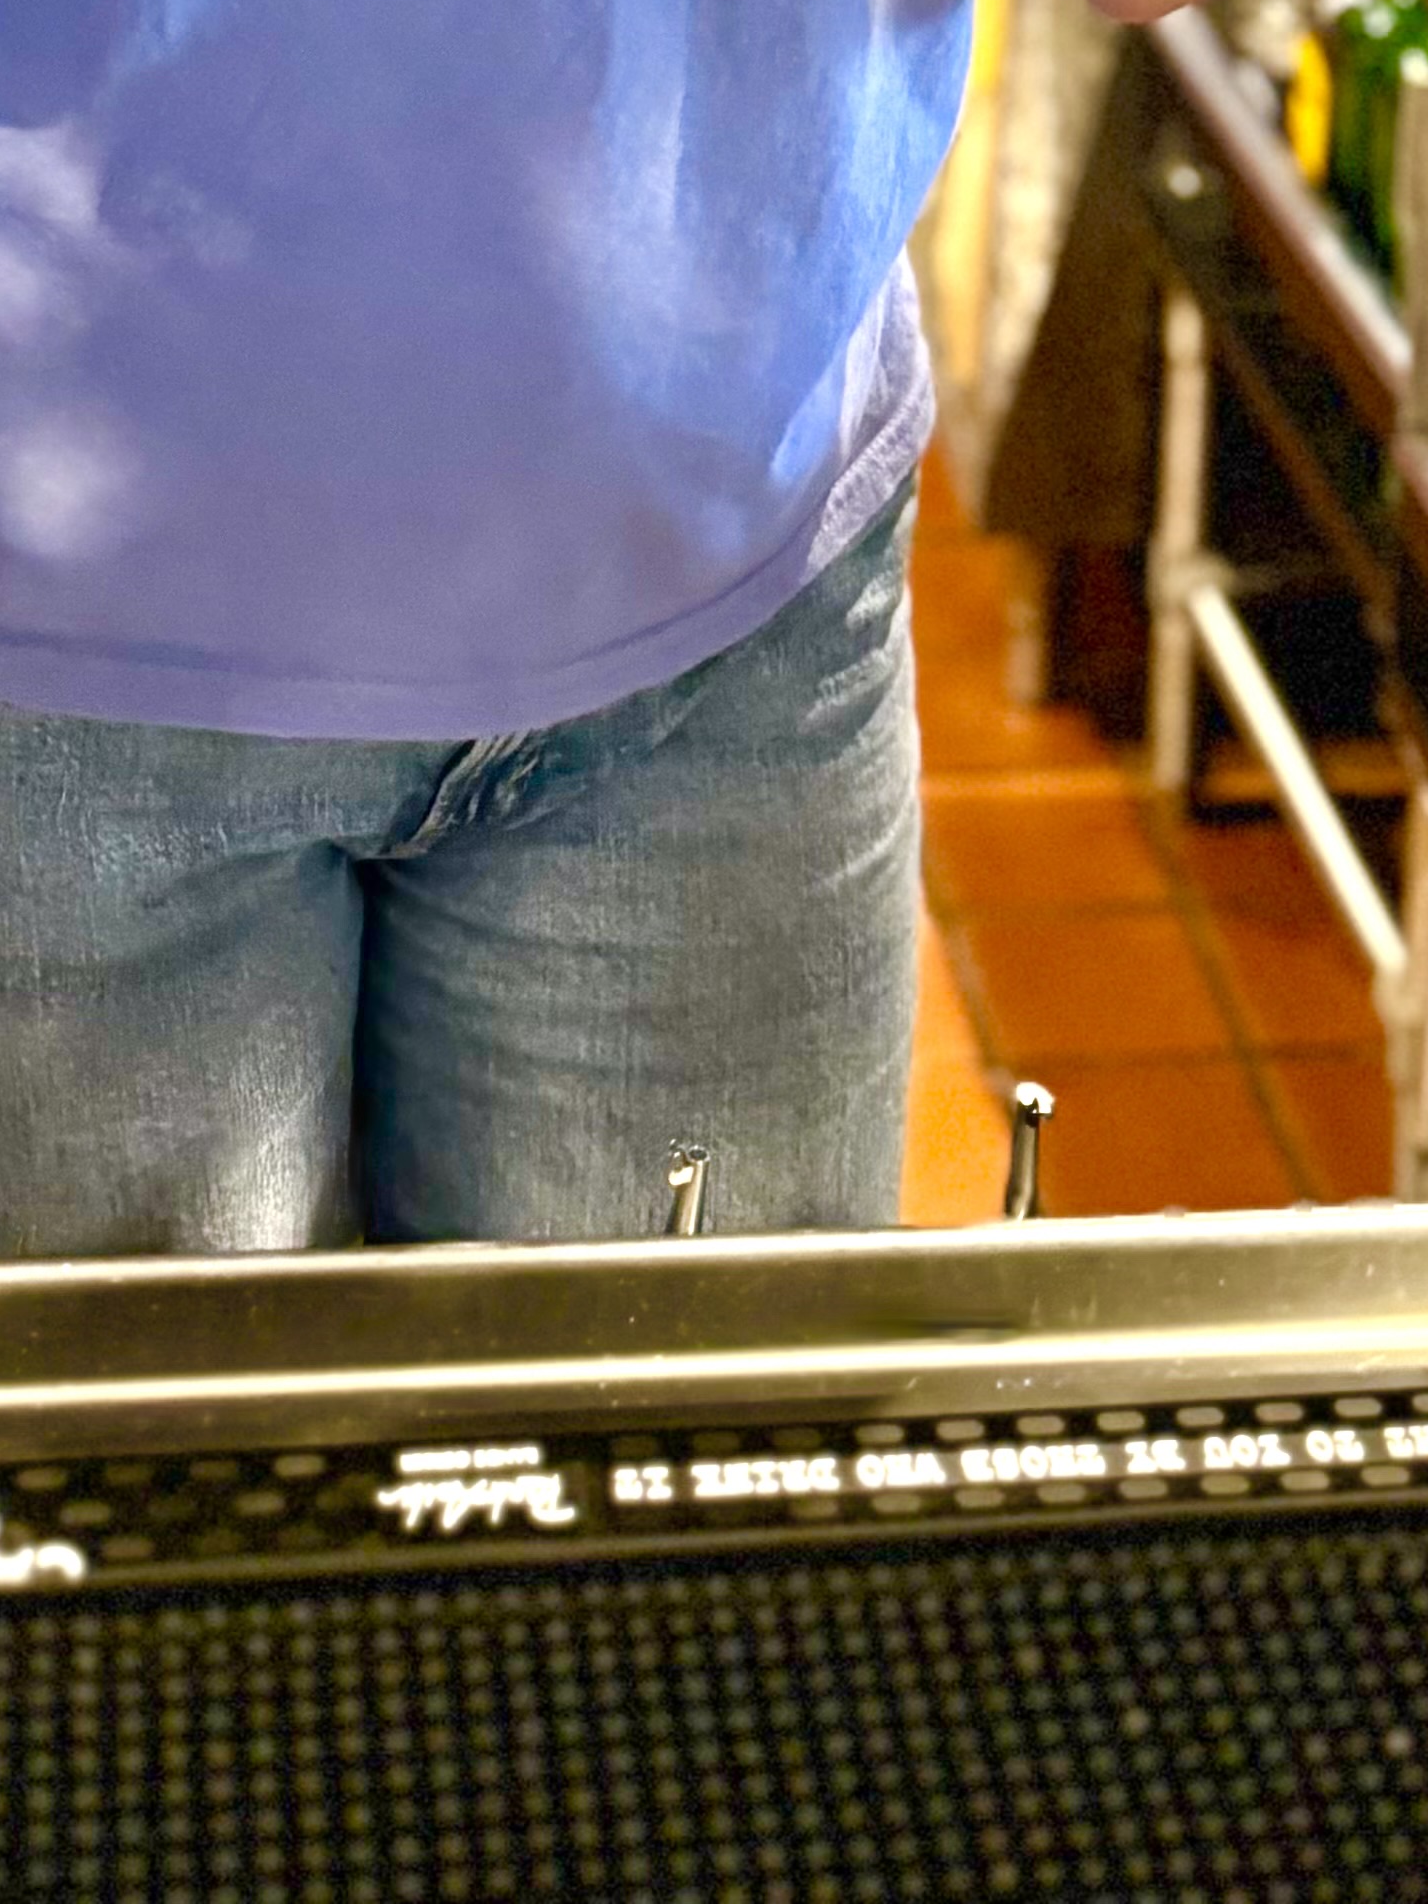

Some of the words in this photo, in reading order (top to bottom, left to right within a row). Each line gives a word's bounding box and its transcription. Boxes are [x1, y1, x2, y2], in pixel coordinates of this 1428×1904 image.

[961, 1444, 1105, 1483] THOSE
[1126, 1440, 1184, 1474] BY
[1203, 1435, 1289, 1469] YOU
[1307, 1429, 1363, 1461] TO
[615, 1466, 671, 1503] IT
[691, 1458, 839, 1498] DRINK
[856, 1452, 945, 1490] WHO
